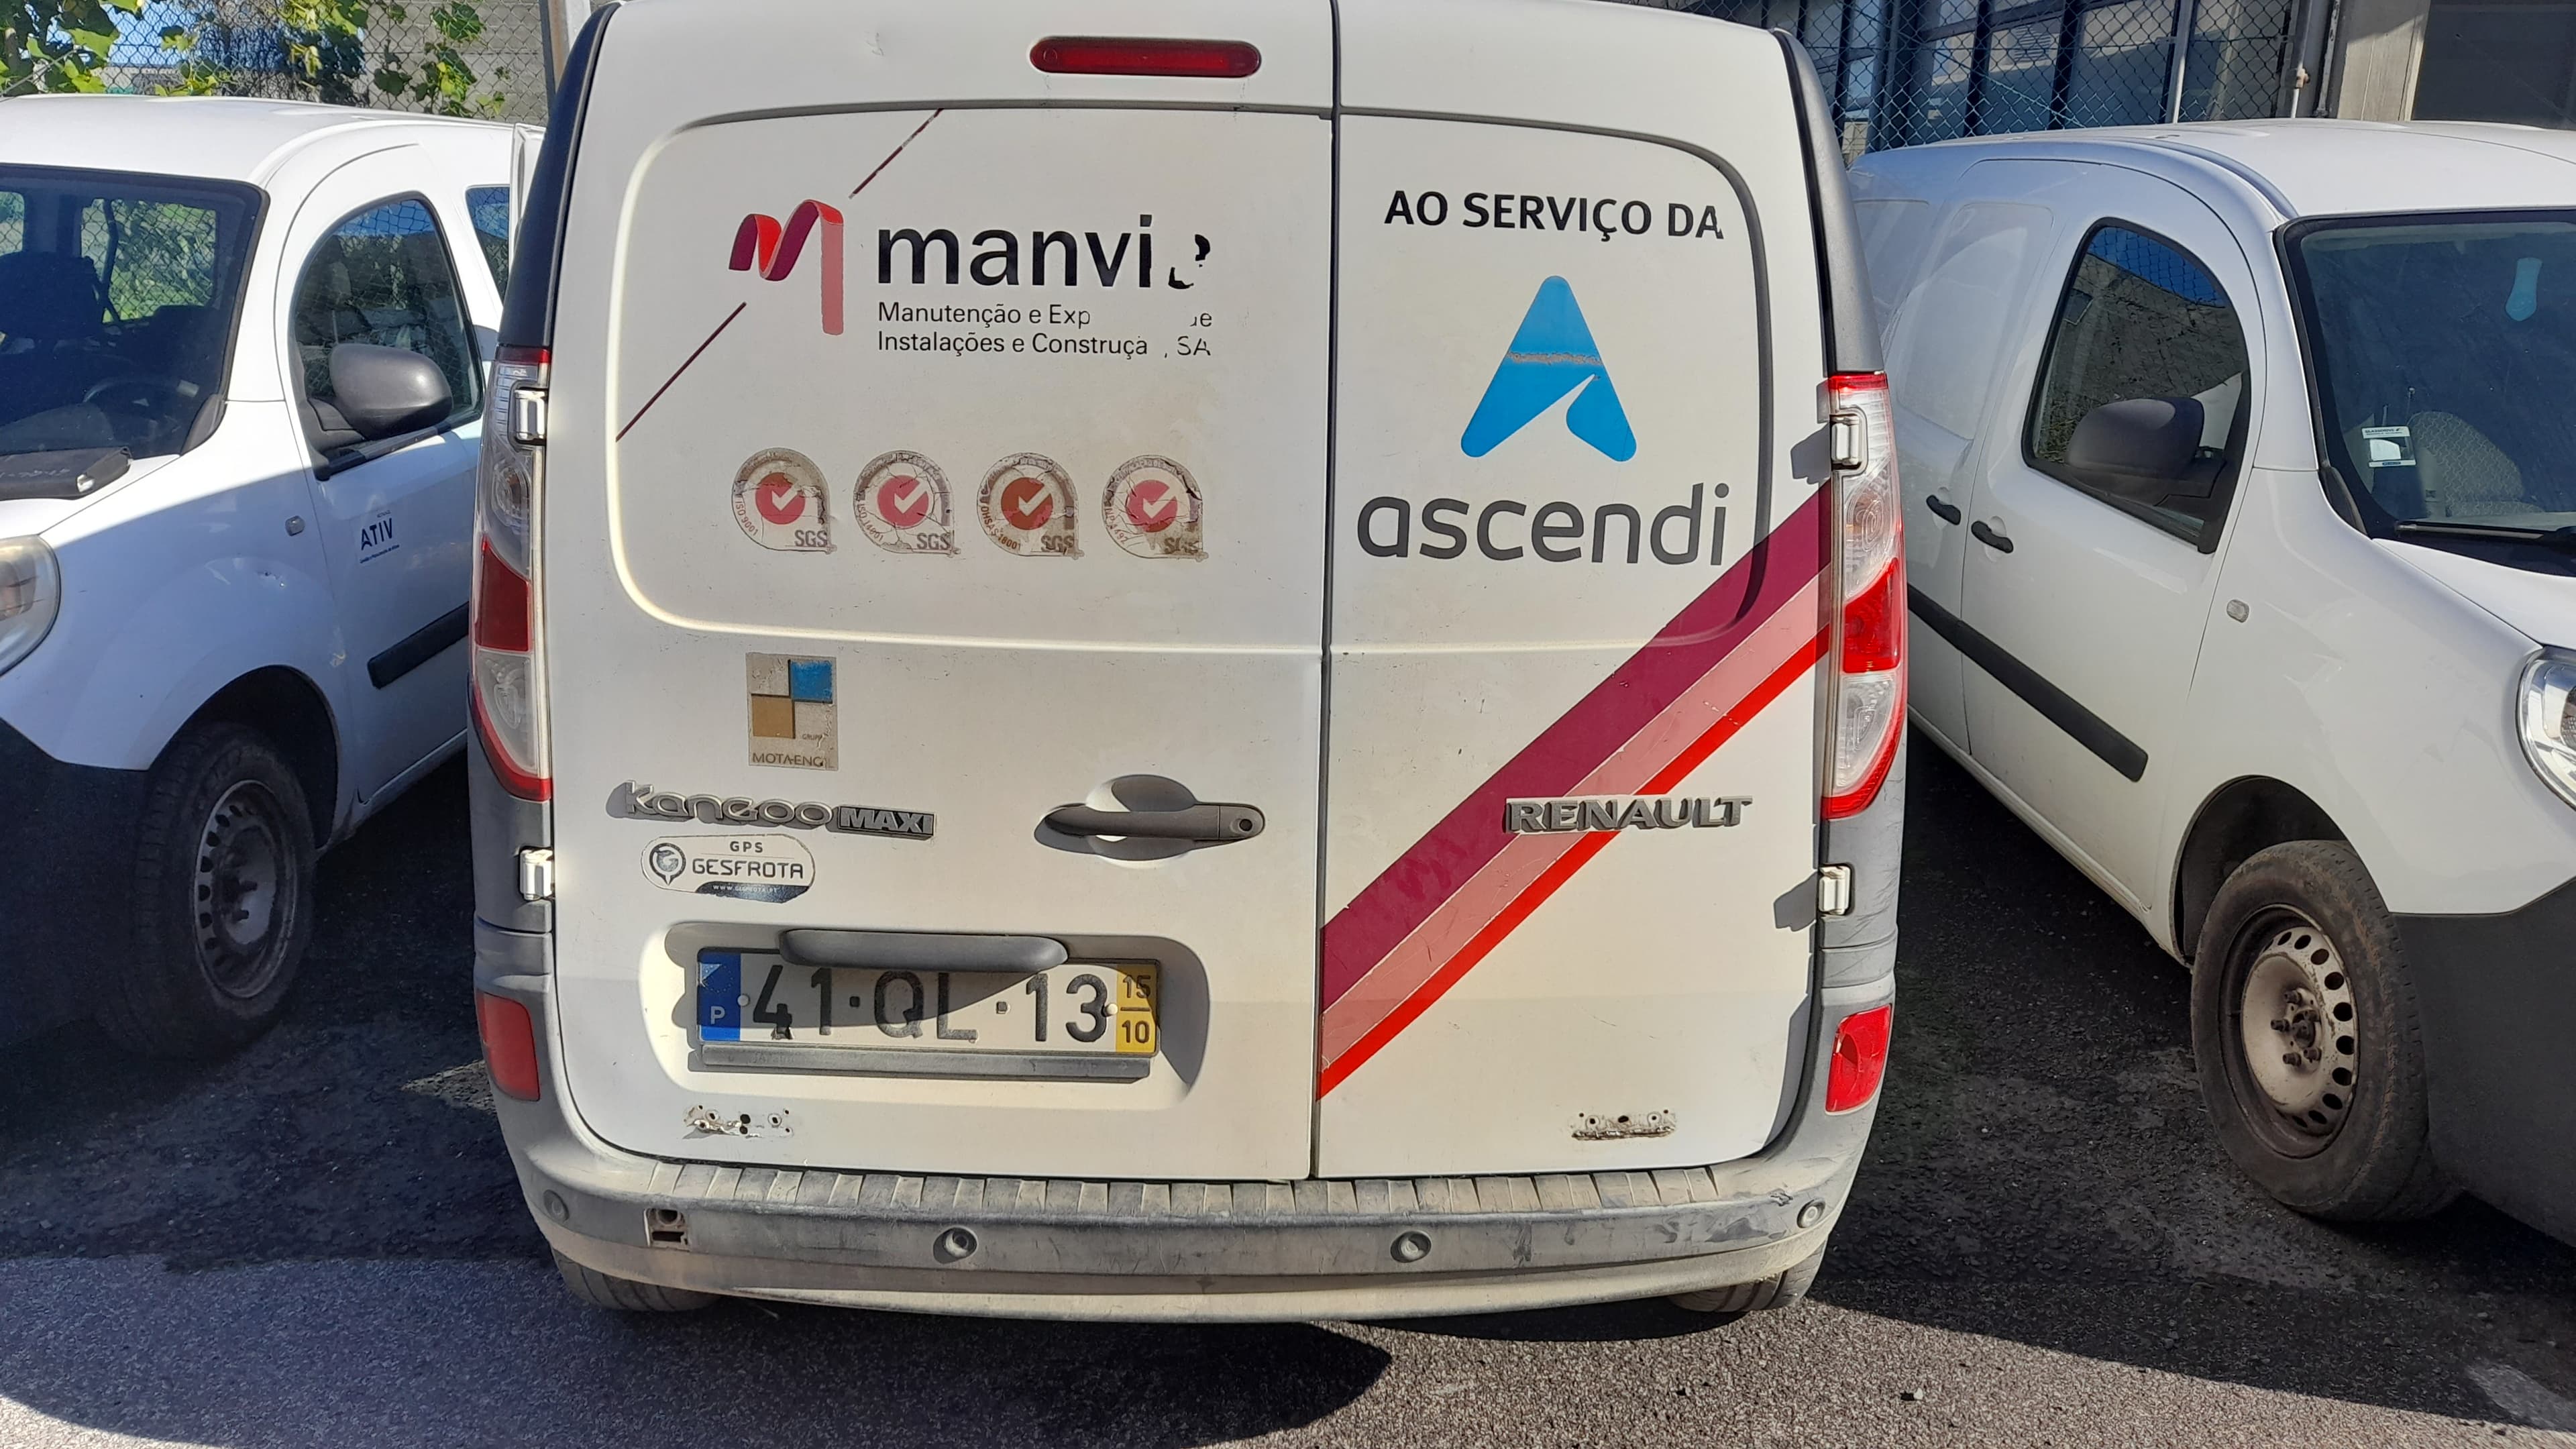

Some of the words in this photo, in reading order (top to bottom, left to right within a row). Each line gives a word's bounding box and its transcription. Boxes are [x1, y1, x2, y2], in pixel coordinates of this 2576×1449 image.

[1384, 191, 1448, 225] AO
[1463, 193, 1652, 242] SERVIÇO
[1668, 203, 1724, 239] DA
[878, 301, 1022, 328] Manutenção
[1028, 308, 1042, 323] e
[878, 331, 1005, 357] Instalações
[1012, 338, 1025, 352] e
[1177, 335, 1212, 356] SA
[735, 501, 747, 516] ISO
[741, 516, 759, 536] 9001
[1357, 482, 1729, 566] ascendi
[361, 517, 392, 551] ATIV
[794, 529, 828, 547] SGS
[916, 532, 951, 550] SGS
[839, 807, 934, 836] MAXI
[1506, 794, 1753, 830] RENAULT
[729, 841, 763, 853] GPS
[692, 858, 804, 879] GESFROTA
[1121, 974, 1152, 999] 15
[710, 1006, 725, 1024] P
[1121, 1020, 1150, 1044] 10
